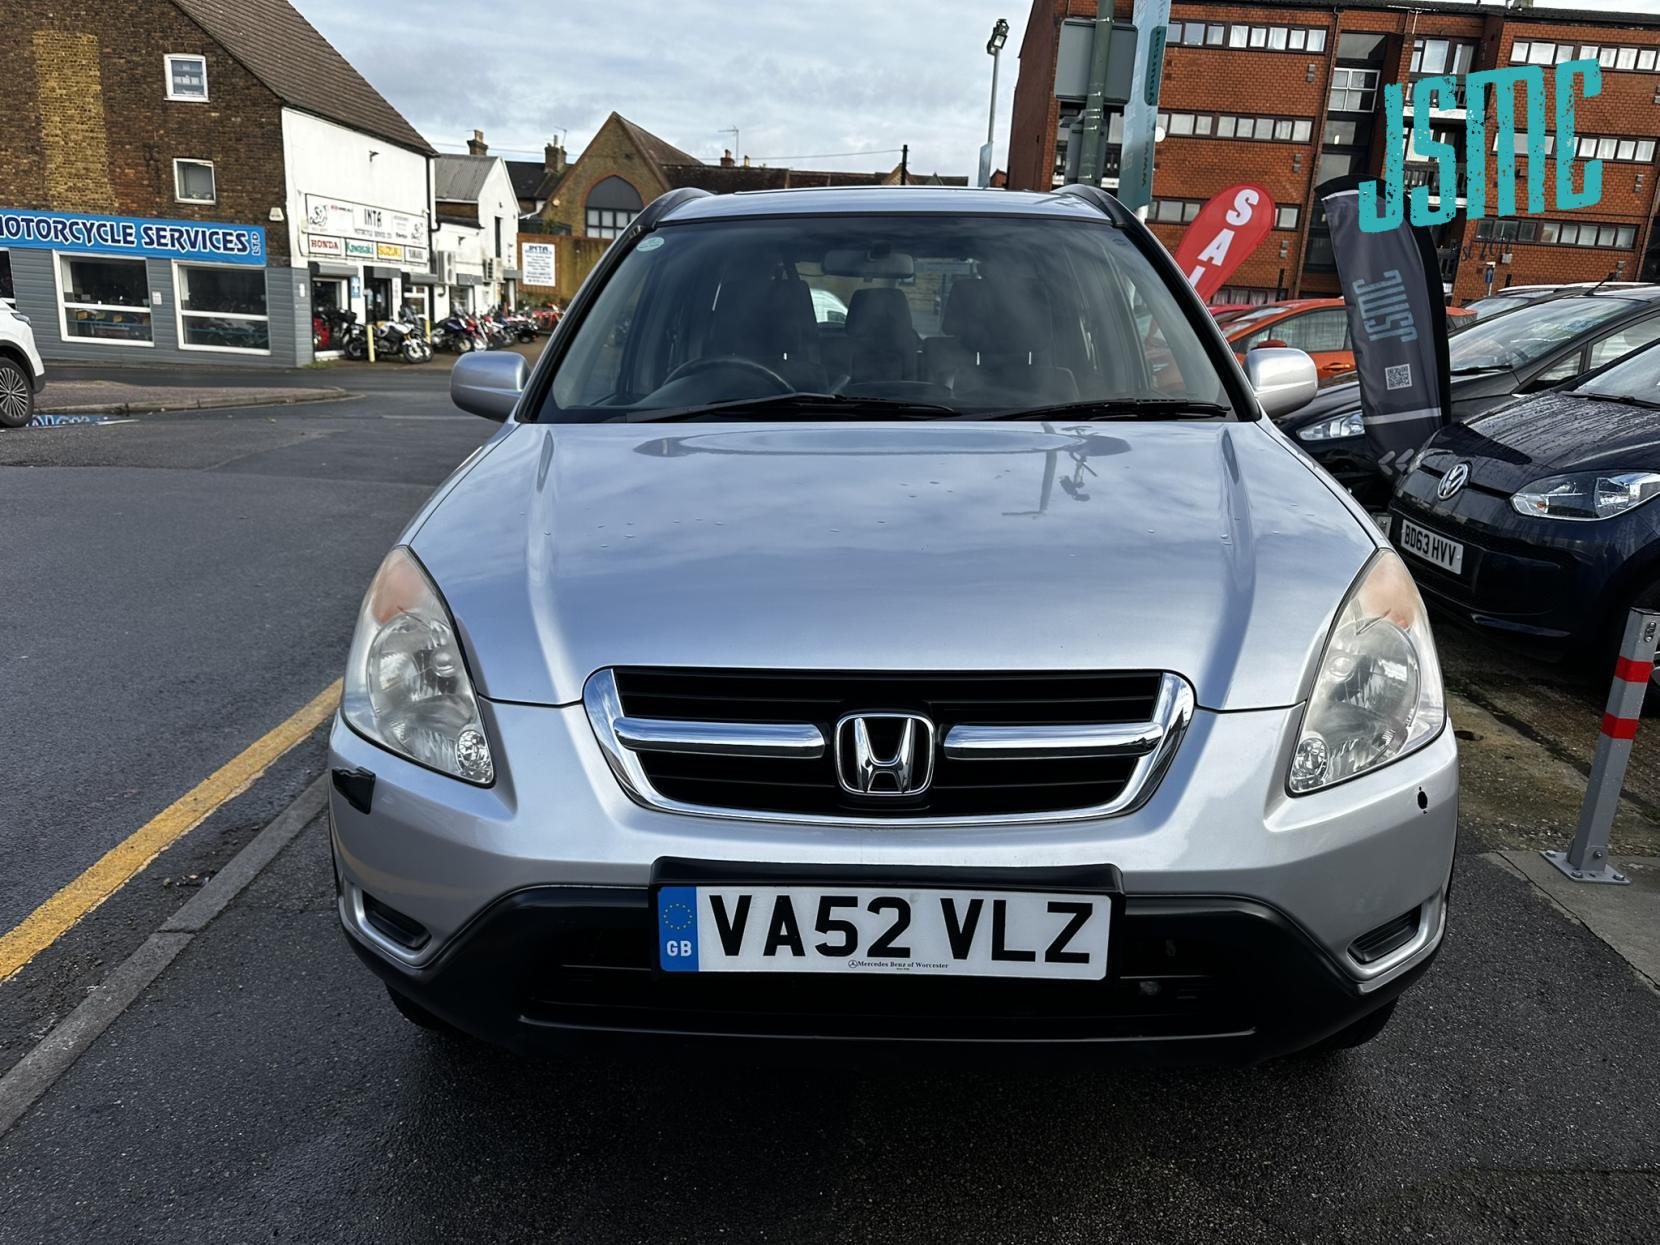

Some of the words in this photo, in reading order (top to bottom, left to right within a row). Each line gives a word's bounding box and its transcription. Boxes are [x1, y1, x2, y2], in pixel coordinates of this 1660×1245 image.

[141, 224, 251, 256] SERVICES
[251, 231, 261, 256] LTD
[310, 239, 339, 250] HONDA
[1352, 269, 1418, 342] JSMC
[1404, 523, 1431, 555] BD63
[1431, 536, 1457, 567] HVV
[708, 894, 912, 958] VA52
[939, 897, 1094, 964] VLZ
[666, 940, 693, 957] GB
[857, 960, 889, 968] Mercedes
[915, 961, 949, 969] Worcester
